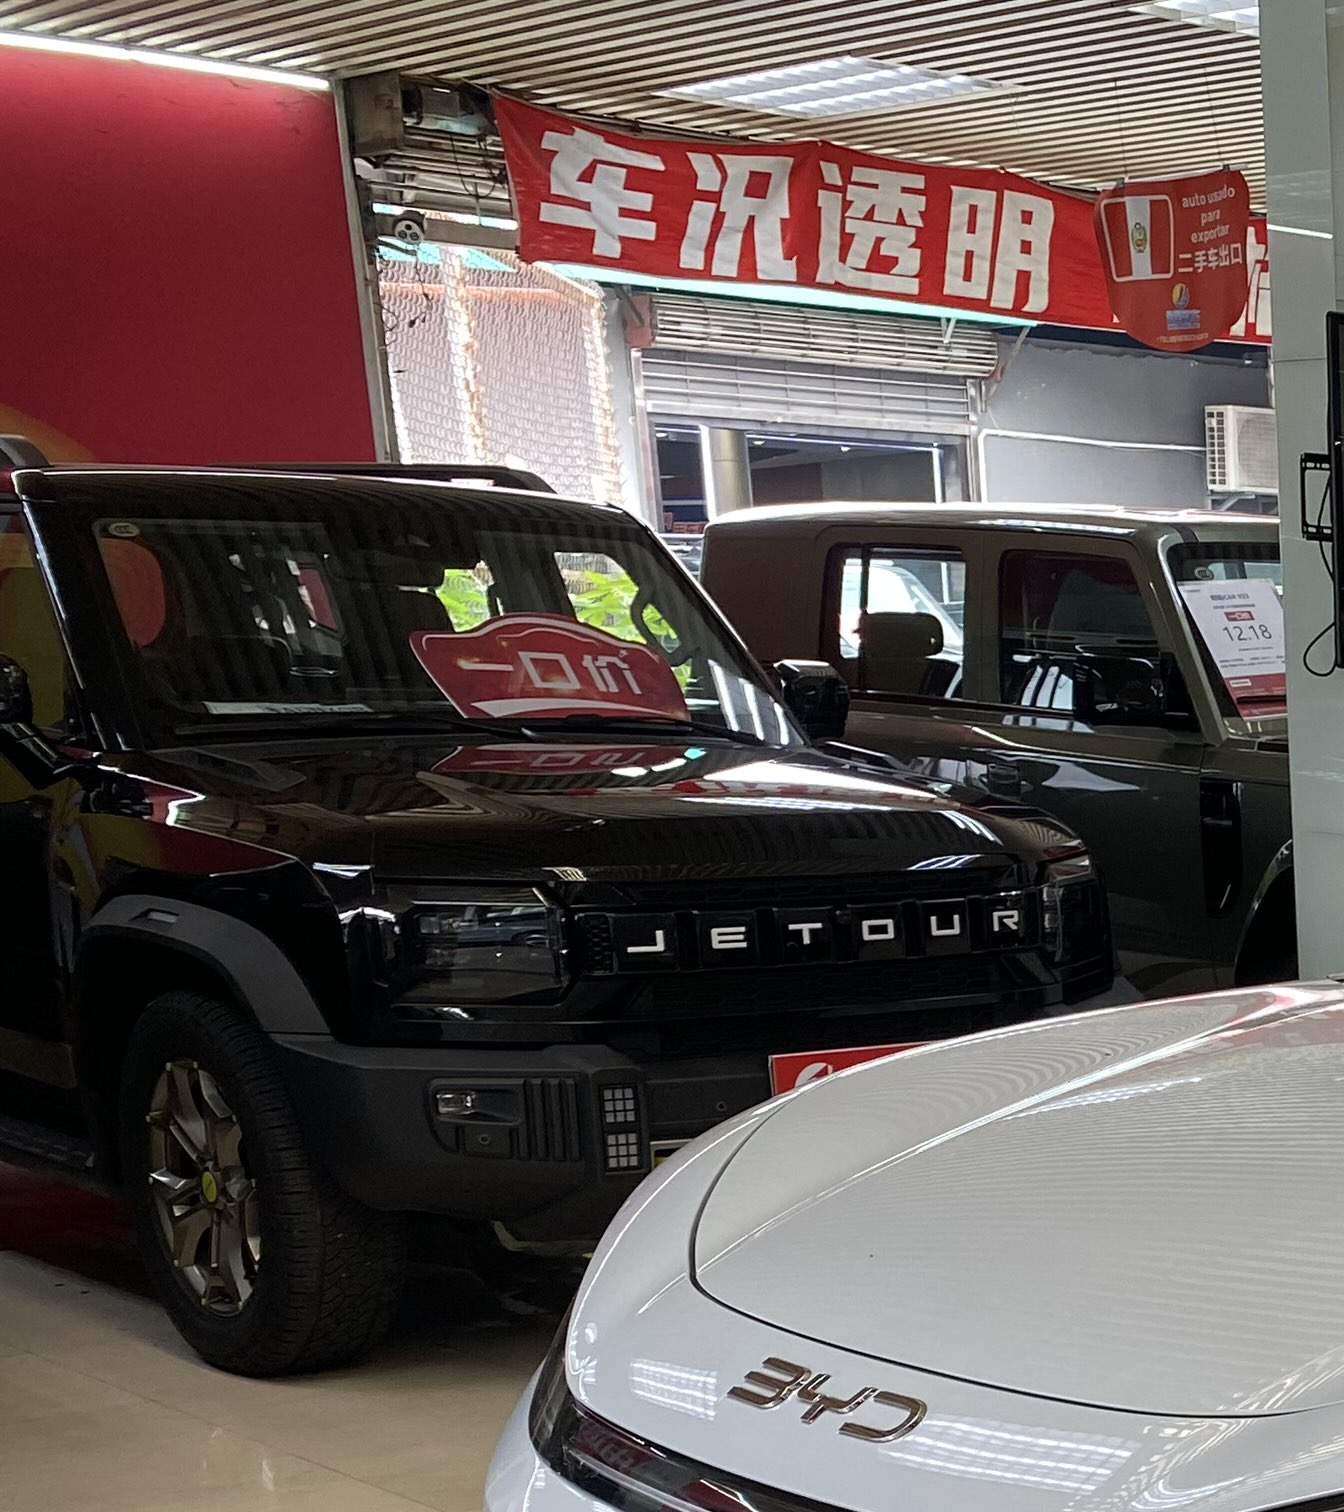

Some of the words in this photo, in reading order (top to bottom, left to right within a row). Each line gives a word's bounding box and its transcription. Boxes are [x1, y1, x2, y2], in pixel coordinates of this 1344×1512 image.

[1182, 194, 1206, 209] auto
[1207, 183, 1236, 204] usado
[538, 126, 1056, 313] 车况透明
[1200, 208, 1221, 227] para
[1190, 223, 1230, 244] exportar
[1178, 243, 1243, 273] 二手车出口
[1223, 623, 1273, 642] 12.18
[457, 650, 642, 695] 一口价
[627, 908, 1020, 953] JETOUR
[727, 1356, 928, 1444] BYD
